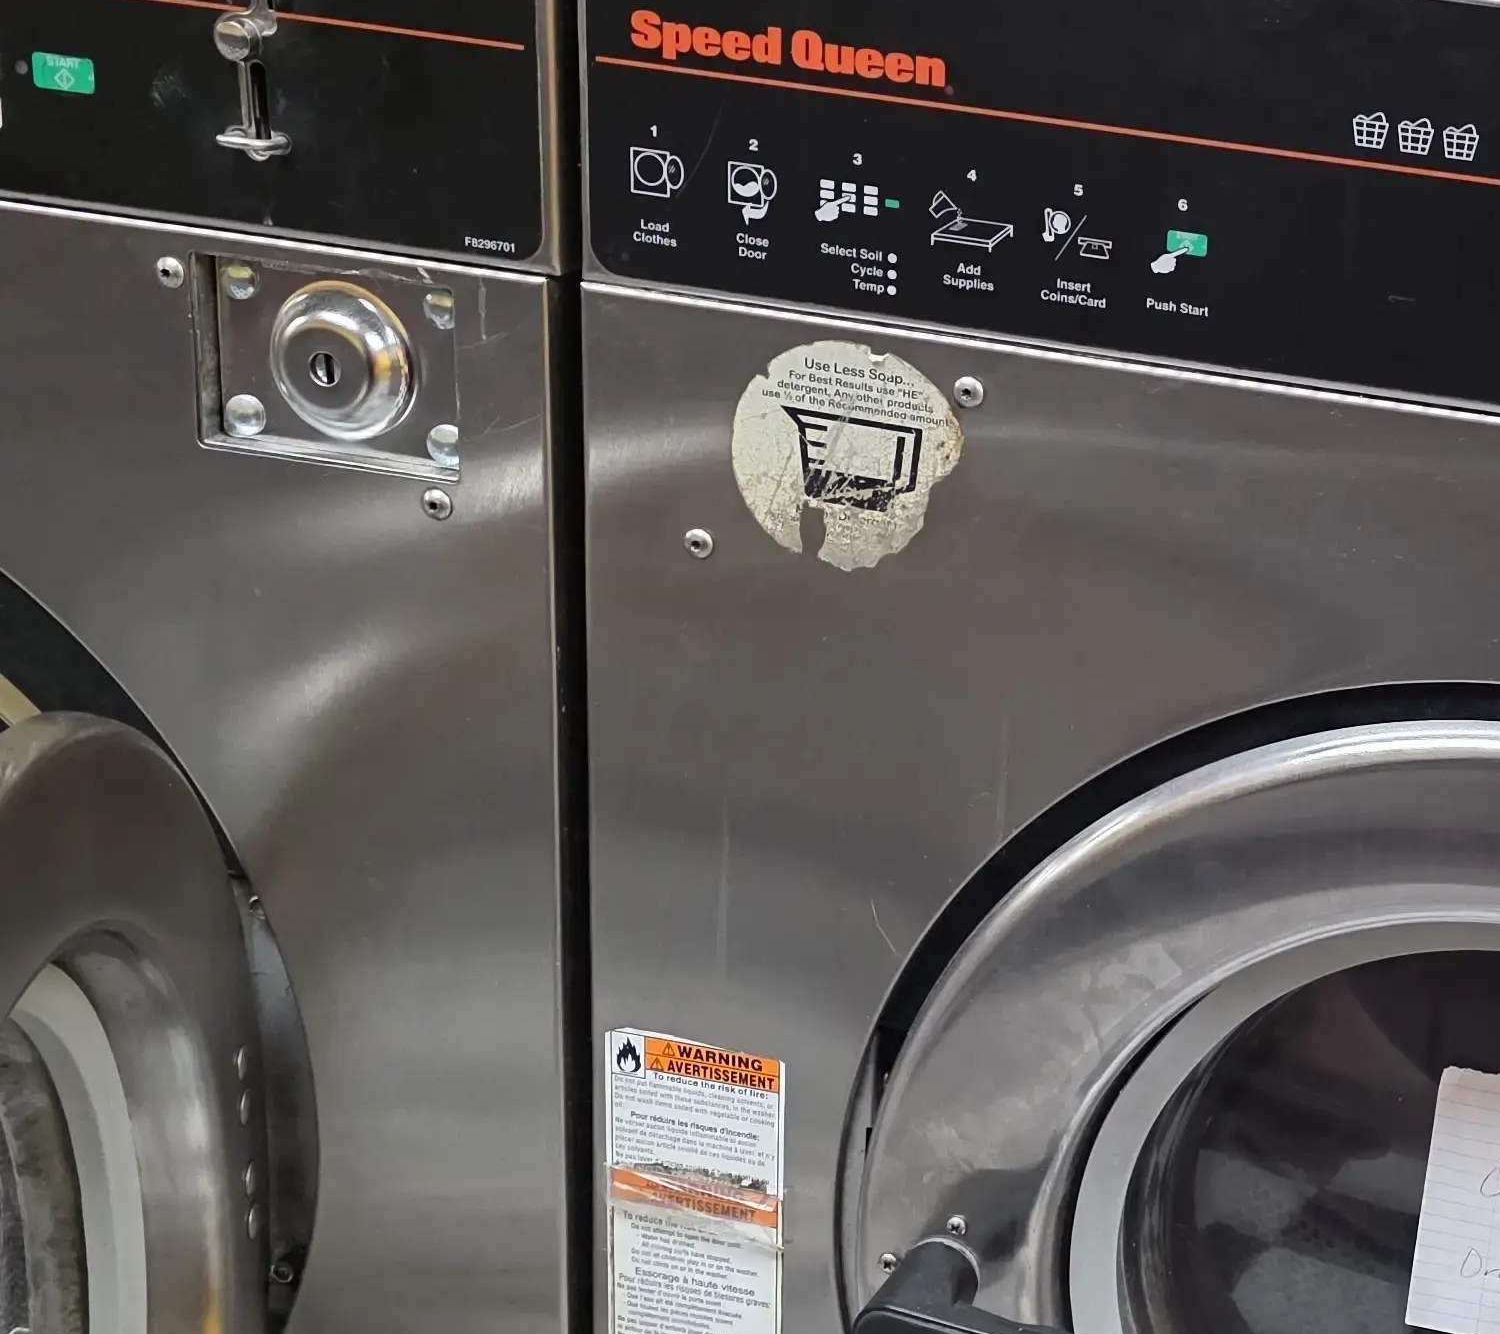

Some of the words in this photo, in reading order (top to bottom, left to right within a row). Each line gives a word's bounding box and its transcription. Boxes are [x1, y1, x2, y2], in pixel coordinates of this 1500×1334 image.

[630, 10, 782, 64] Speed
[792, 29, 945, 87] Queen
[650, 125, 657, 137] 1
[749, 139, 758, 151] 2
[853, 153, 862, 165] 3
[967, 170, 976, 181] 4
[1074, 184, 1083, 196] 5
[1178, 199, 1188, 211] 6
[641, 219, 669, 232] Load
[465, 237, 514, 252] F8296701
[633, 231, 676, 247] Clothes
[736, 233, 769, 247] Close
[739, 247, 766, 259] Door
[821, 243, 856, 257] Select
[860, 249, 882, 261] Soil
[851, 263, 883, 277] Cycle
[957, 263, 980, 275] Add
[853, 279, 884, 294] Temp
[943, 274, 994, 291] Supplies
[1057, 278, 1090, 292] Insert
[1041, 290, 1106, 308] Coins/Card
[1147, 298, 1176, 312] Push
[1180, 303, 1208, 316] Start
[805, 358, 830, 373] Use
[835, 363, 865, 379] Less
[789, 370, 806, 381] For
[809, 373, 832, 386] Best
[835, 378, 873, 392] Results
[877, 384, 894, 396] use
[762, 387, 780, 399] use
[795, 393, 805, 403] of
[809, 395, 825, 407] the
[888, 397, 933, 414] products
[678, 1045, 762, 1072] WARNING
[667, 1059, 774, 1091] AVERTISSEMENT
[654, 1072, 663, 1081] To
[667, 1075, 698, 1087] reduce
[701, 1081, 715, 1090] the
[718, 1084, 735, 1094] risk
[738, 1087, 747, 1096] of
